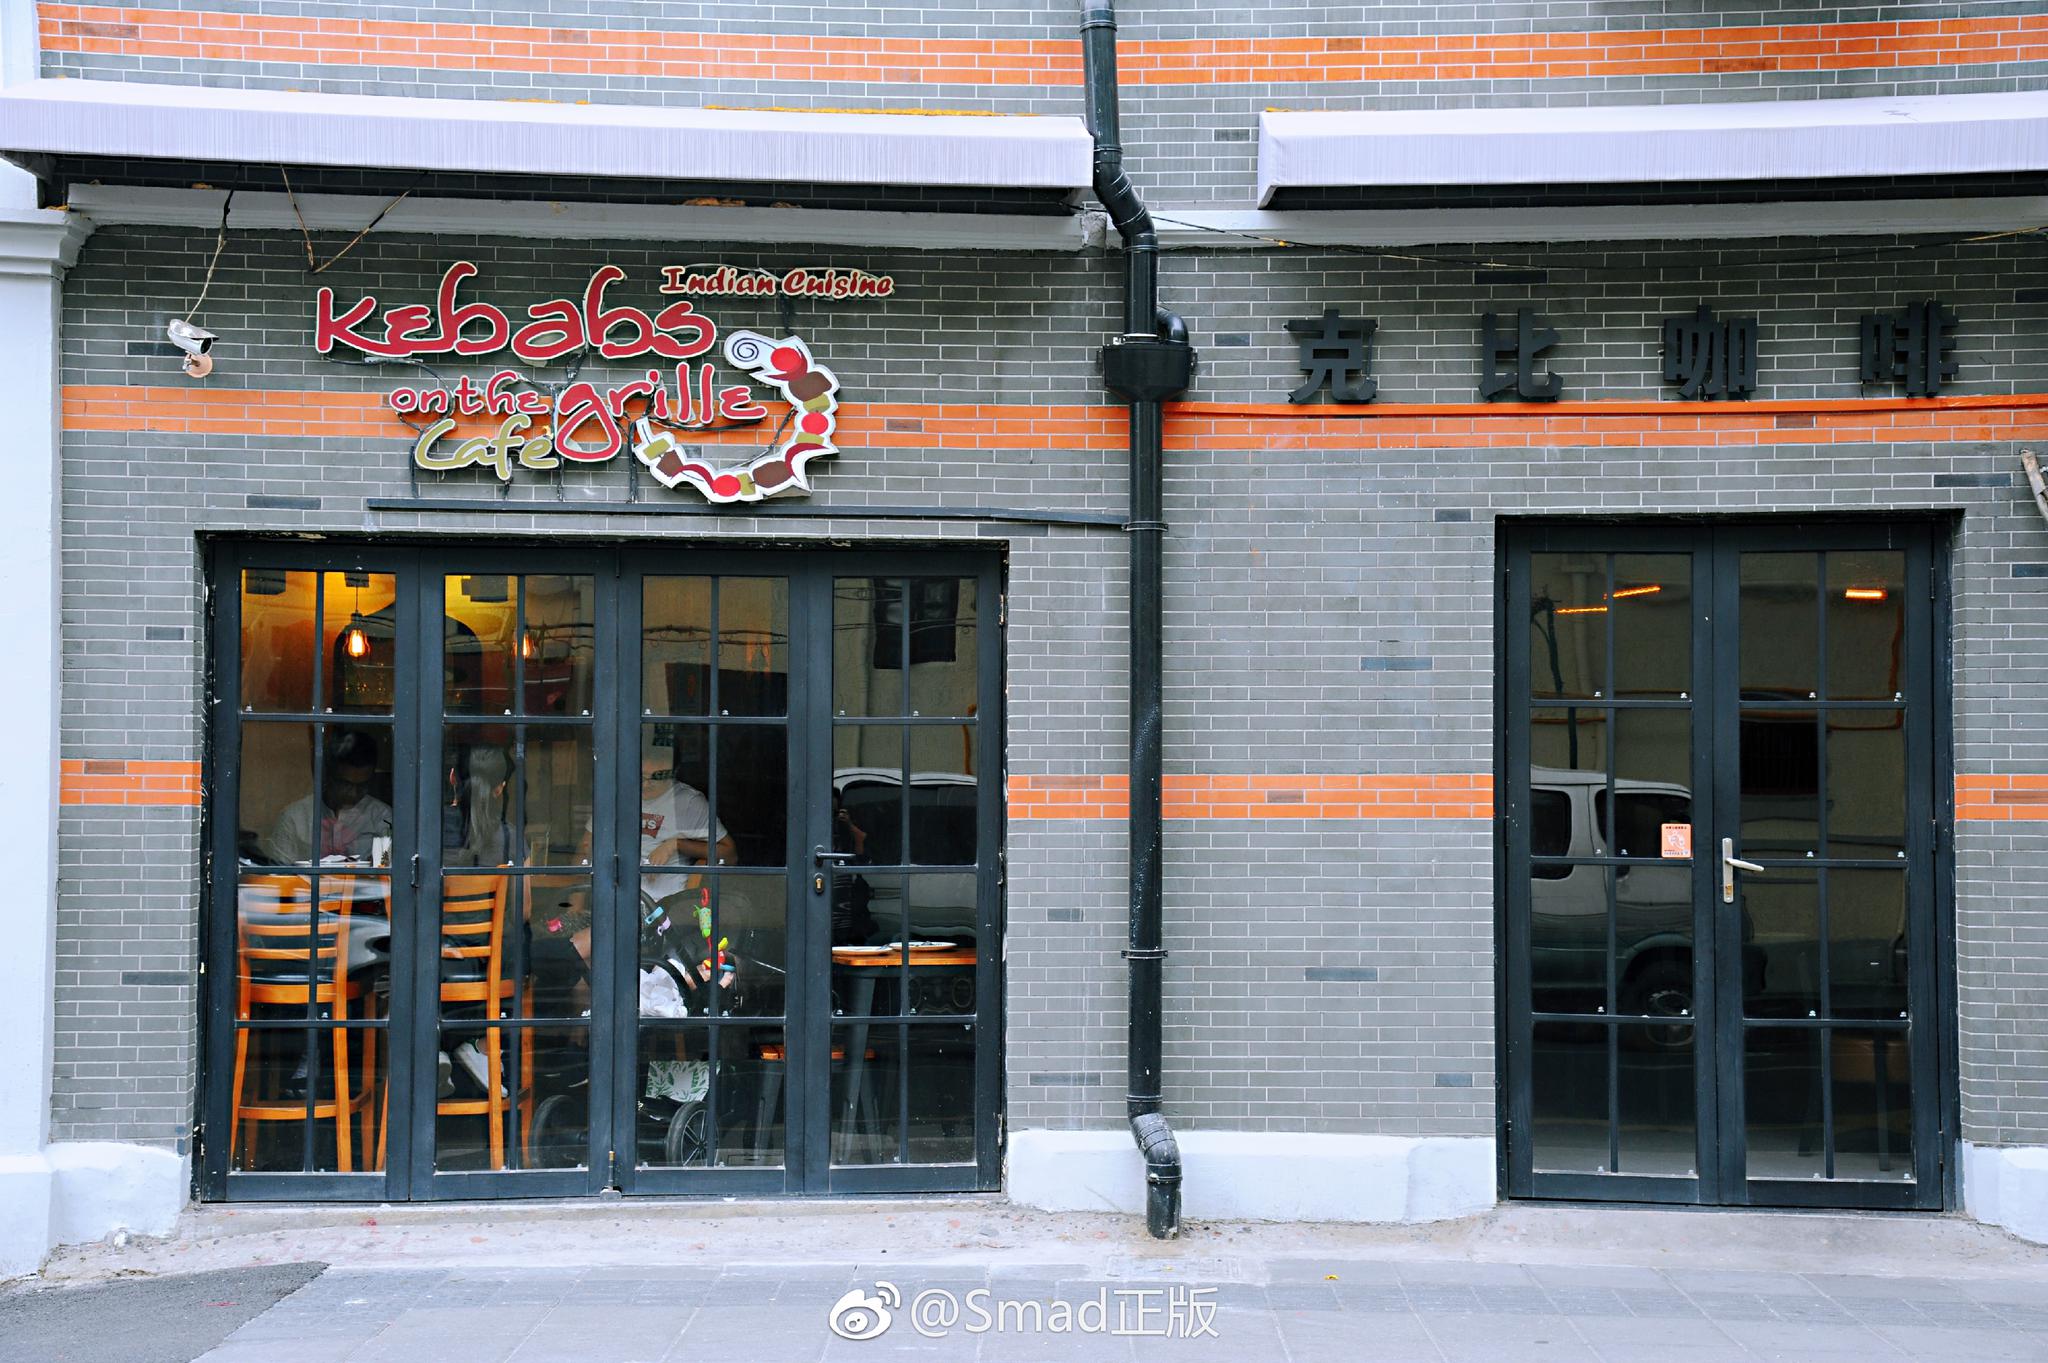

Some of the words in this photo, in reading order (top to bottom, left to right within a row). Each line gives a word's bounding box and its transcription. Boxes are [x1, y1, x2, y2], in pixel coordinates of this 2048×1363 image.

[314, 261, 718, 360] Kebabs
[659, 265, 776, 295] Indian
[781, 269, 894, 298] Cuisine
[1287, 301, 1957, 403] 克比咖啡
[556, 362, 768, 462] grille
